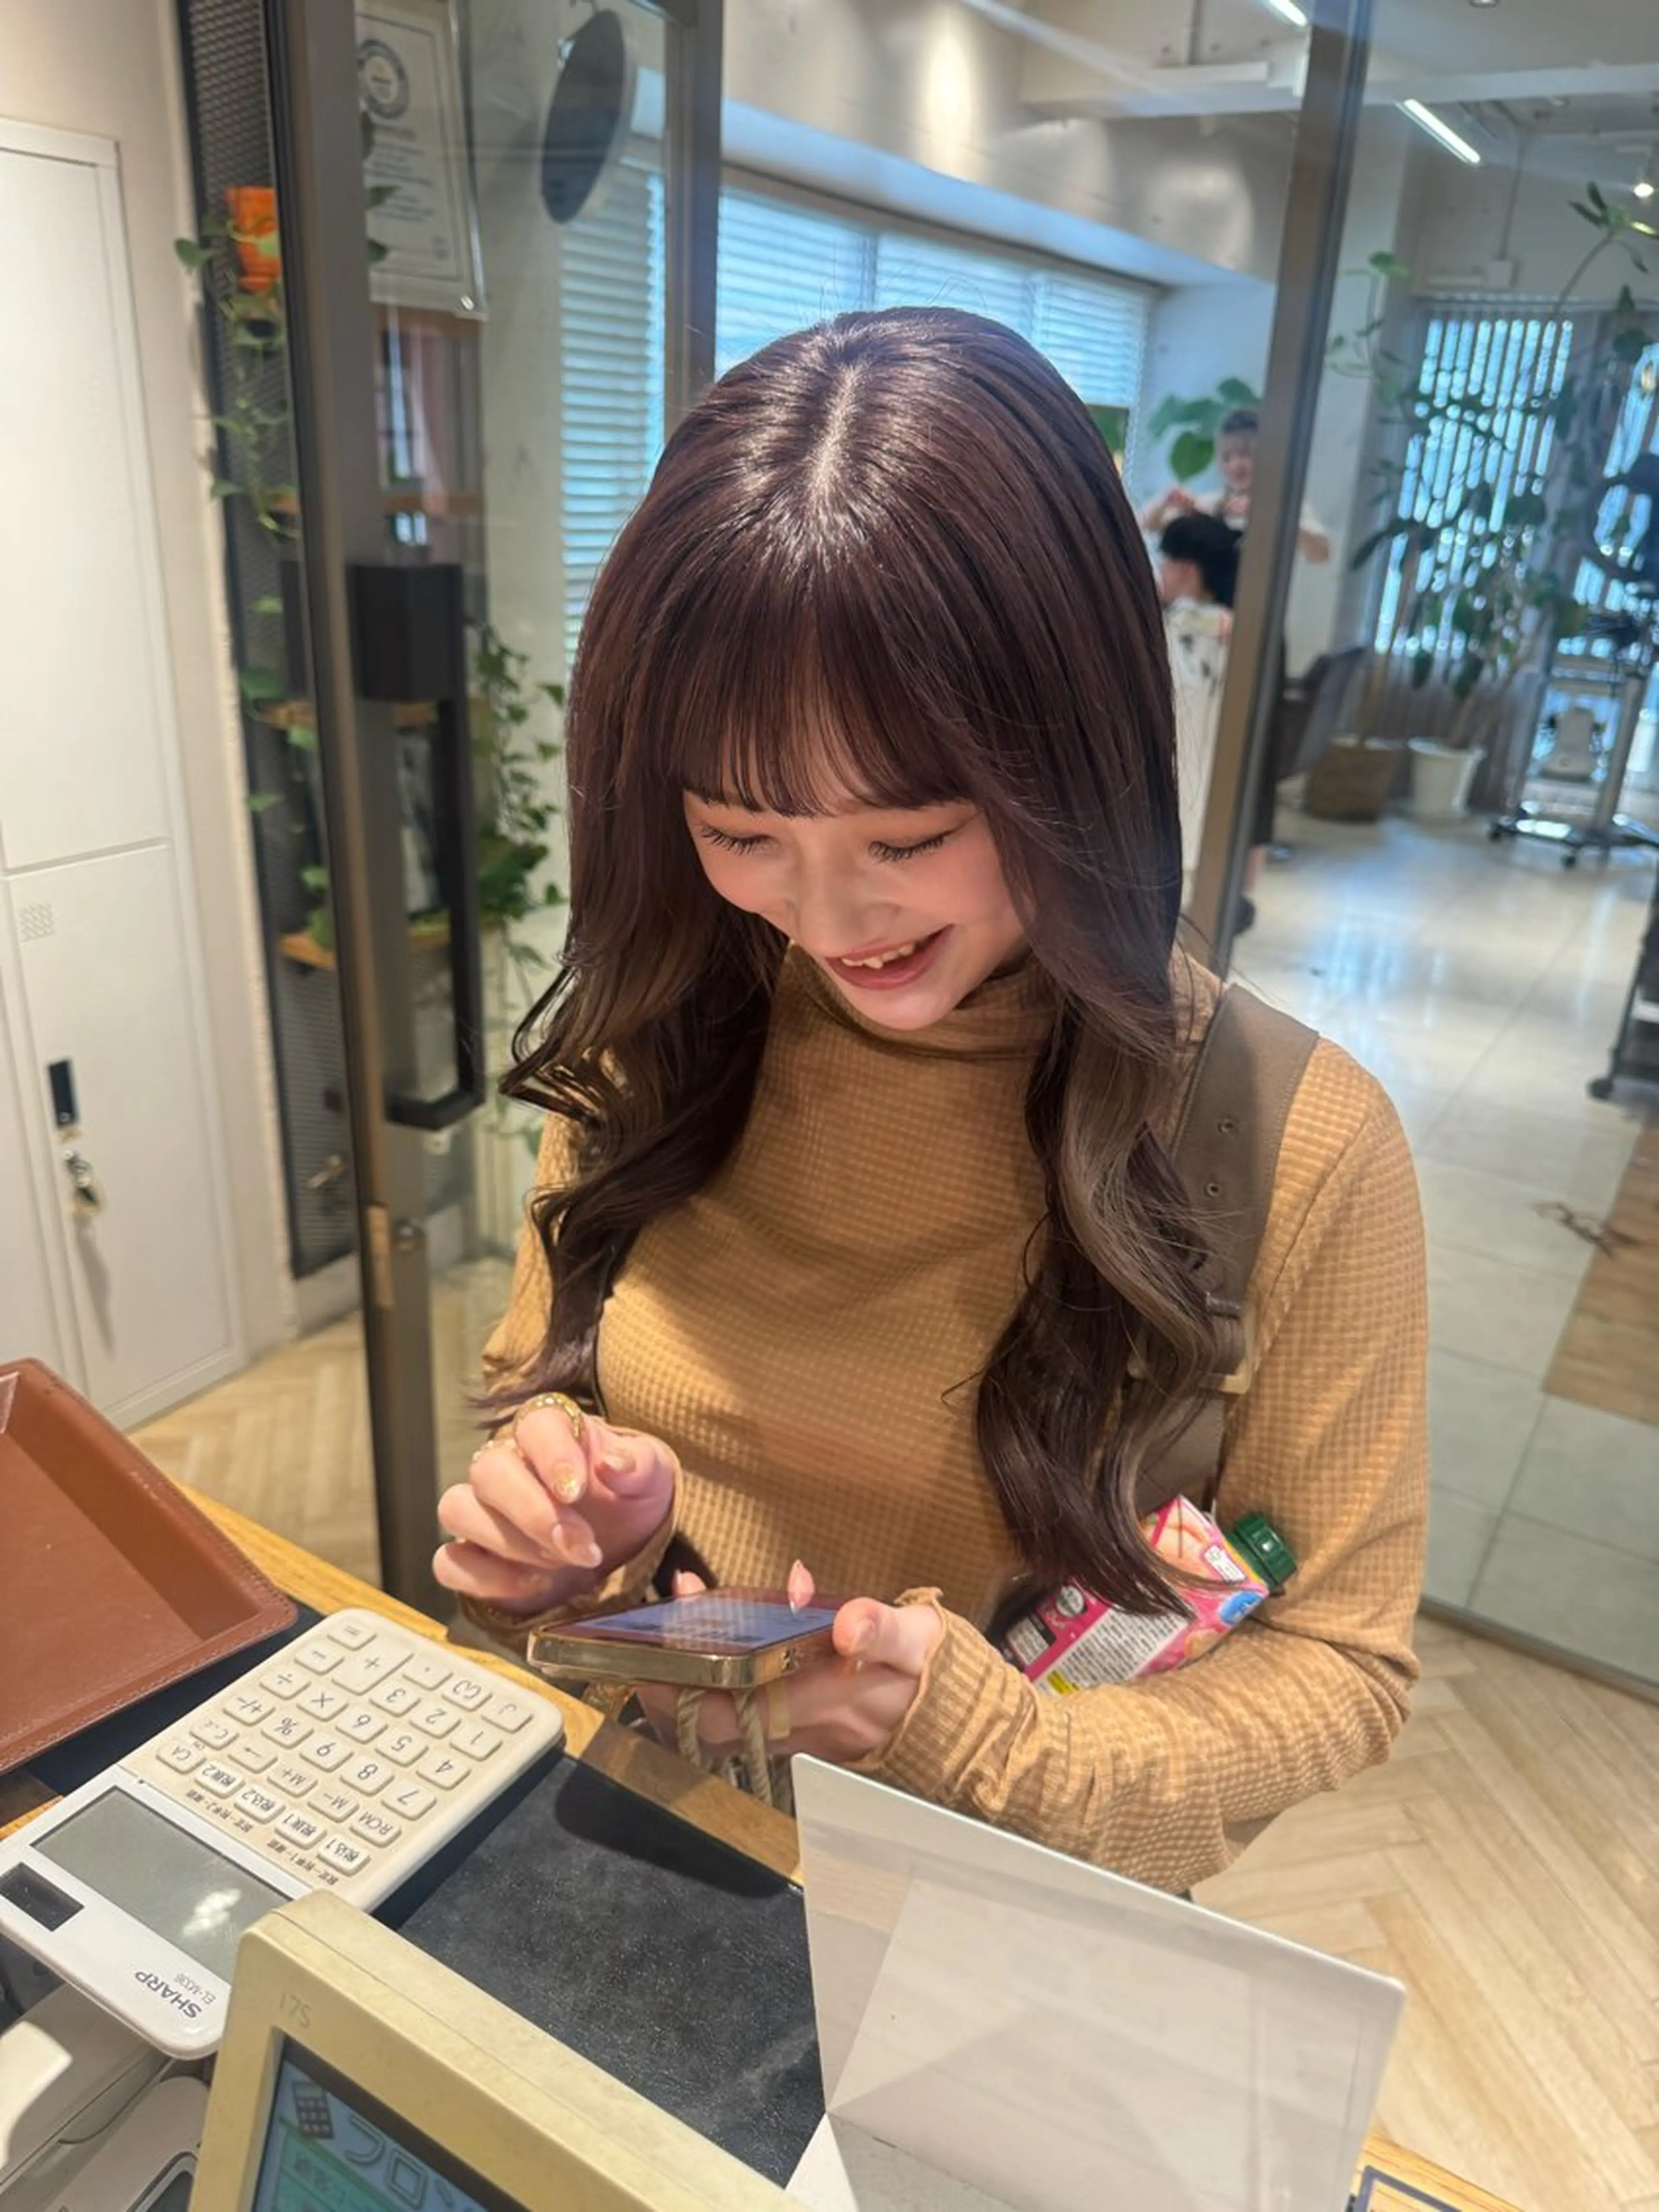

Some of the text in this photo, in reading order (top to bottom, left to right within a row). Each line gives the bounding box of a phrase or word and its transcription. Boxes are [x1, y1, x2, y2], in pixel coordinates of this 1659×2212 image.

[386, 1688, 406, 1703] 3
[352, 1715, 371, 1728] 6
[426, 1708, 447, 1724] 2
[391, 1735, 413, 1751] 5
[469, 1731, 484, 1745] 1
[317, 1742, 337, 1757] 9
[358, 1764, 378, 1780] 8
[435, 1759, 453, 1773] 4
[397, 1790, 419, 1805] 7
[135, 1971, 202, 2018] SHARP
